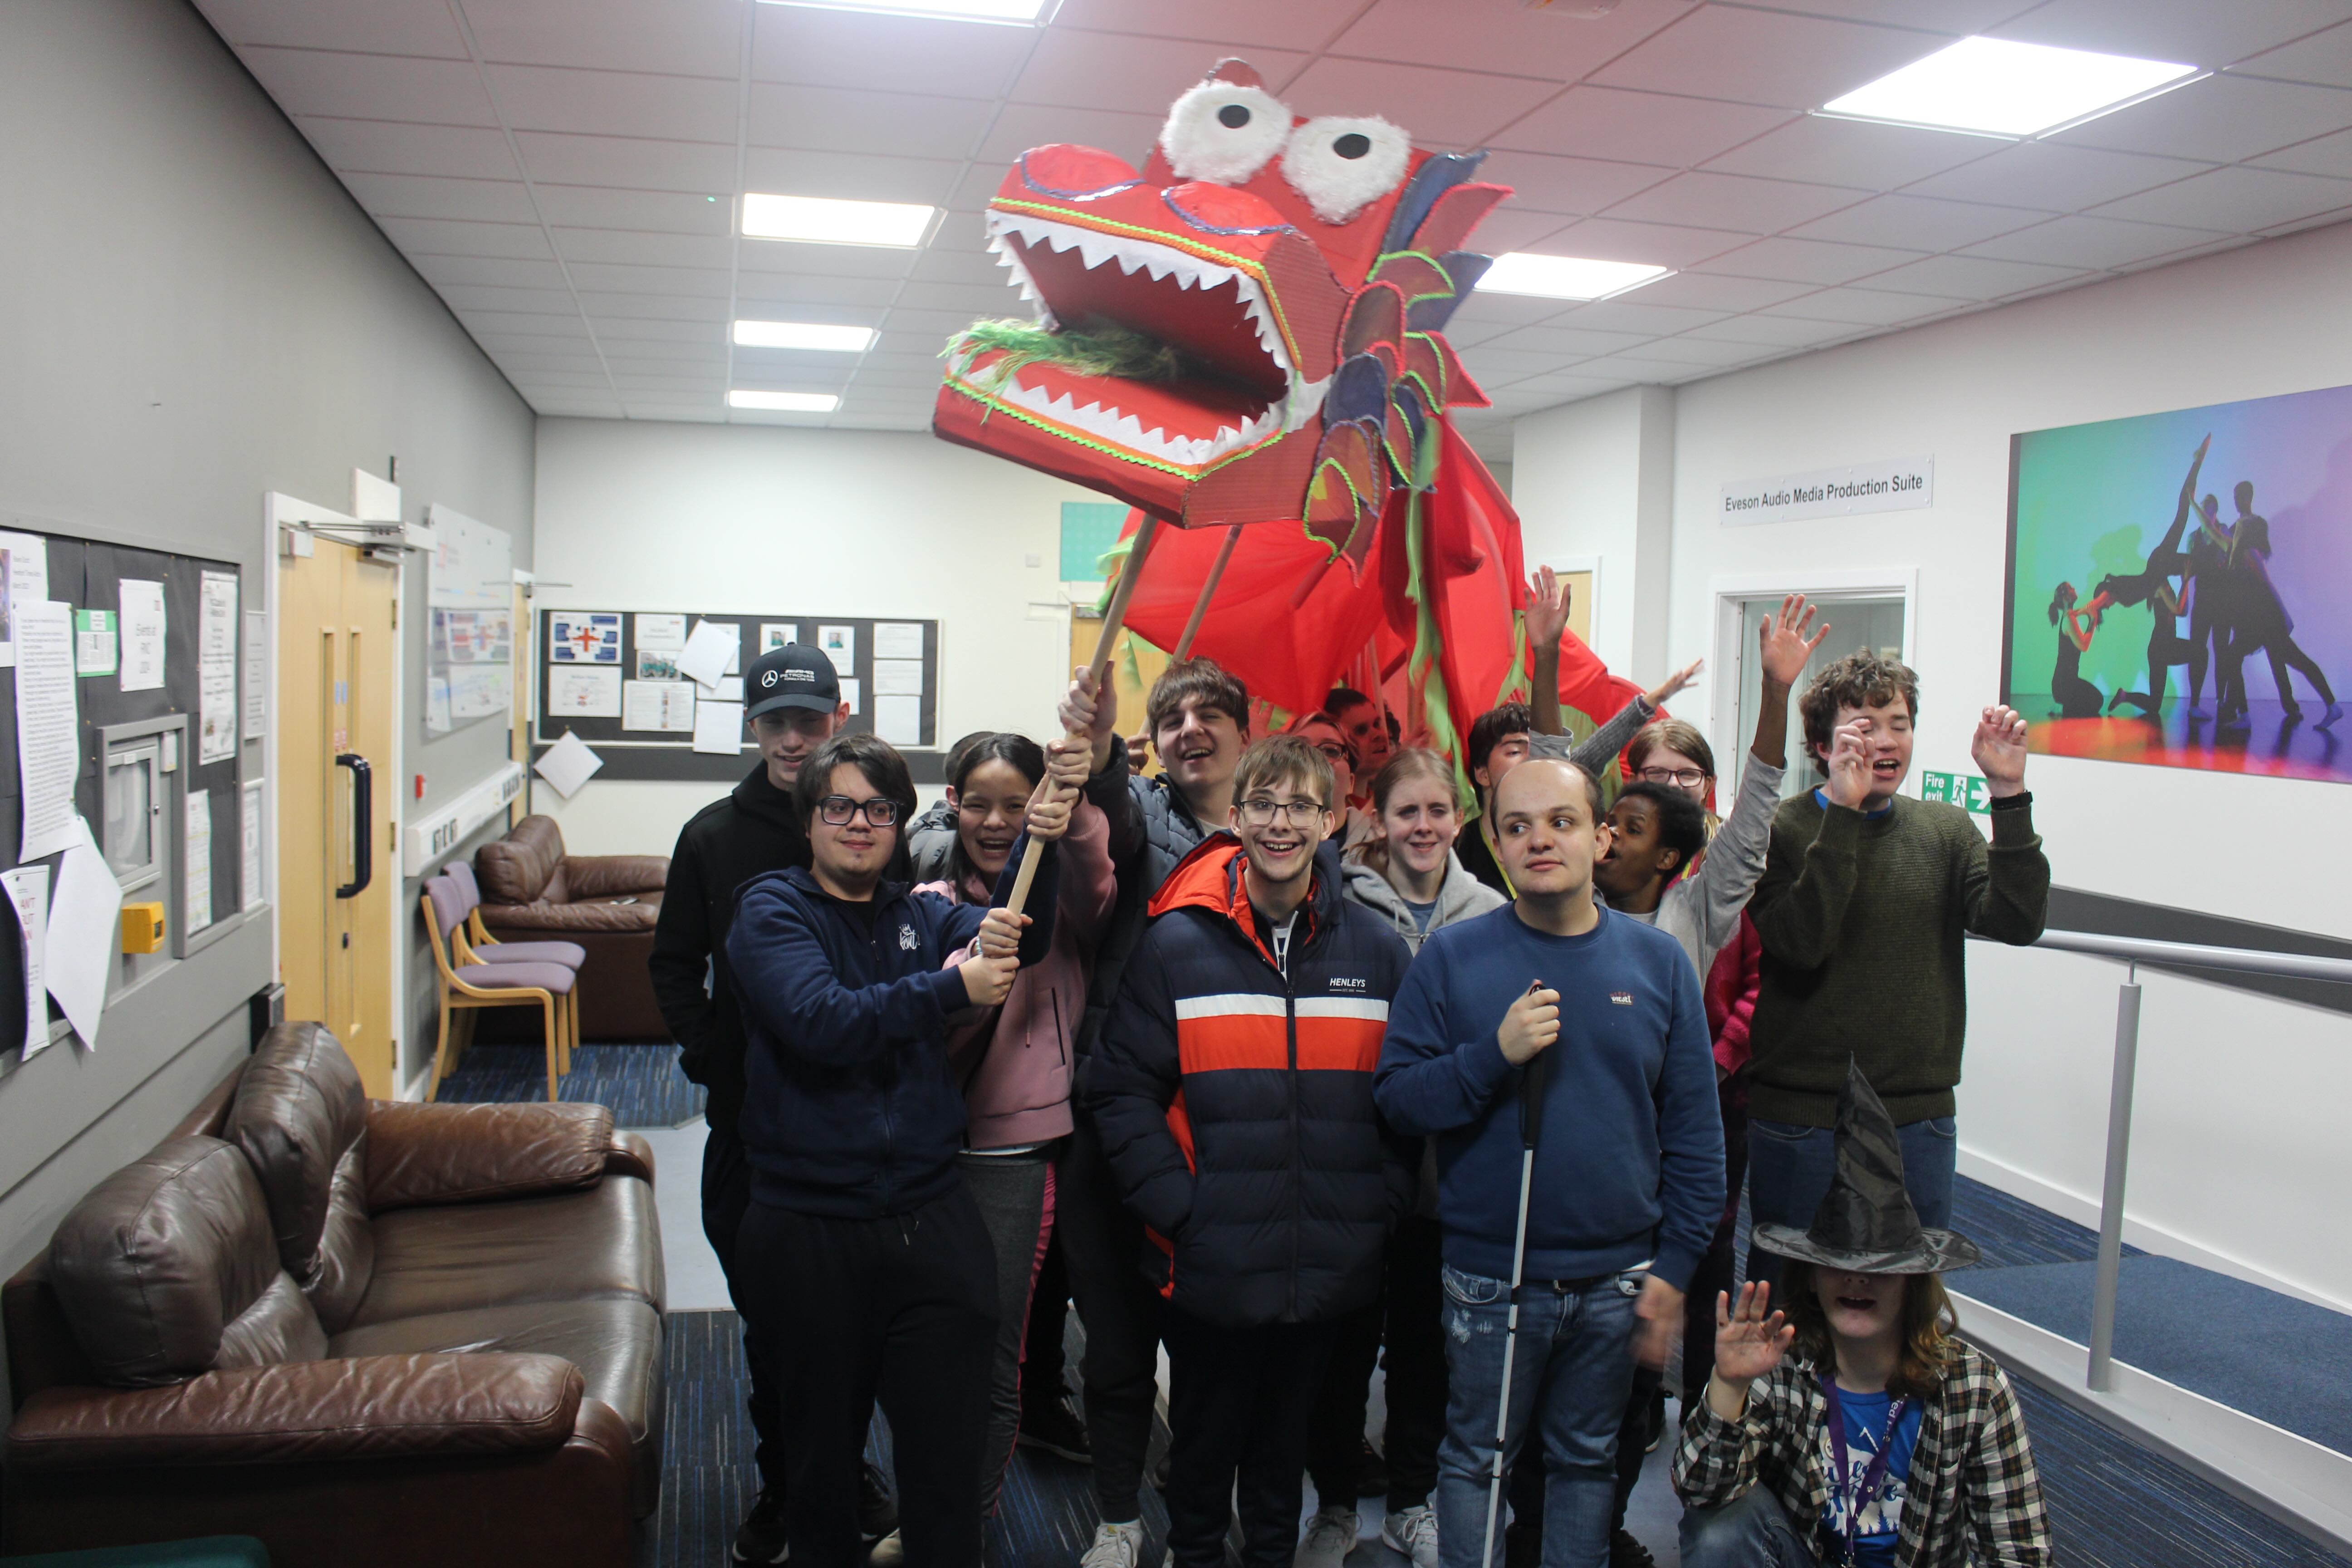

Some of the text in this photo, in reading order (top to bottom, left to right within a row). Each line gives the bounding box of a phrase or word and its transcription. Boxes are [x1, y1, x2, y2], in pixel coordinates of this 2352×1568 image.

[1725, 474, 1923, 511] Eveson Audio Media Production Suite
[1926, 773, 1945, 789] Fire
[1926, 790, 1943, 802] exit
[1329, 978, 1366, 987] HENLEYS
